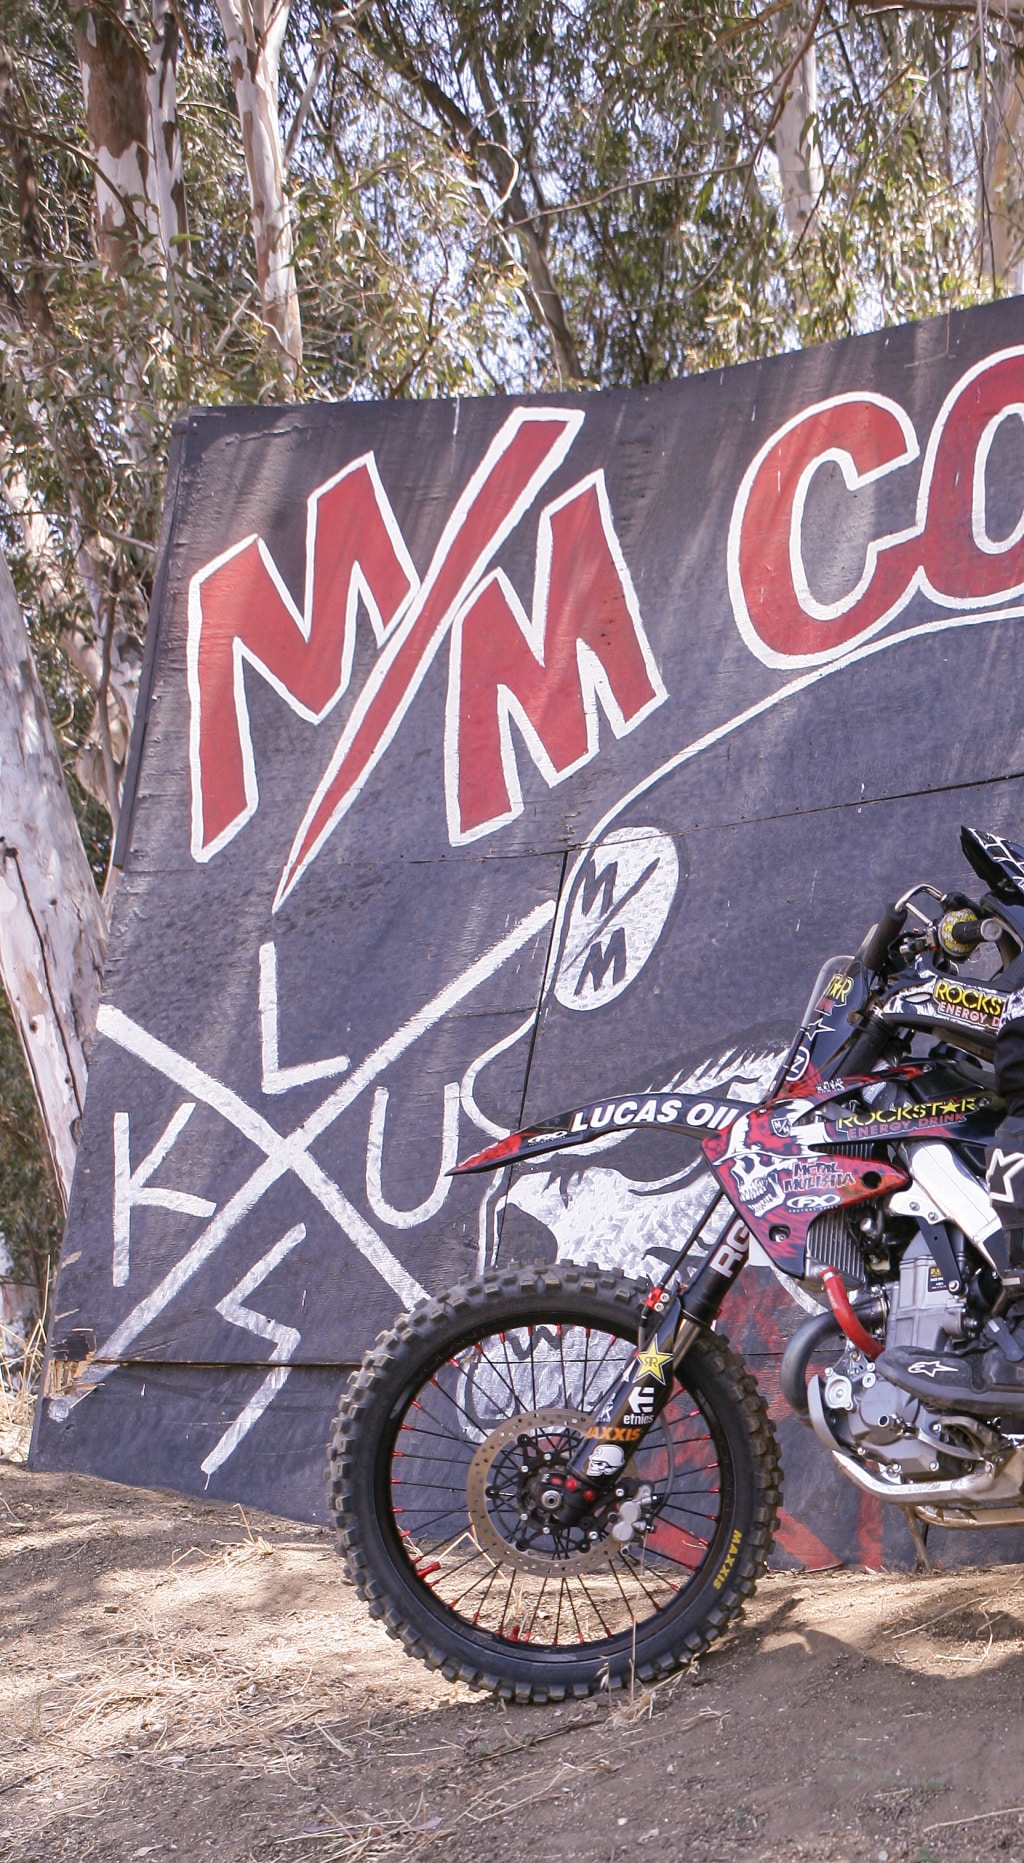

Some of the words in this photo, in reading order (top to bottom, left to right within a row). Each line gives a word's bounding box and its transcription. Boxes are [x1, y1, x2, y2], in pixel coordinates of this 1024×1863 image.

[939, 1003, 988, 1024] ENERGY
[569, 1099, 682, 1133] LUCAS
[838, 1097, 977, 1129] ROCKSTAR
[851, 1120, 911, 1139] ENERGY
[918, 1112, 966, 1128] DRINK
[623, 1413, 655, 1425] etnies
[586, 1427, 641, 1441] AXXIS
[714, 1530, 742, 1590] MAXXIS
